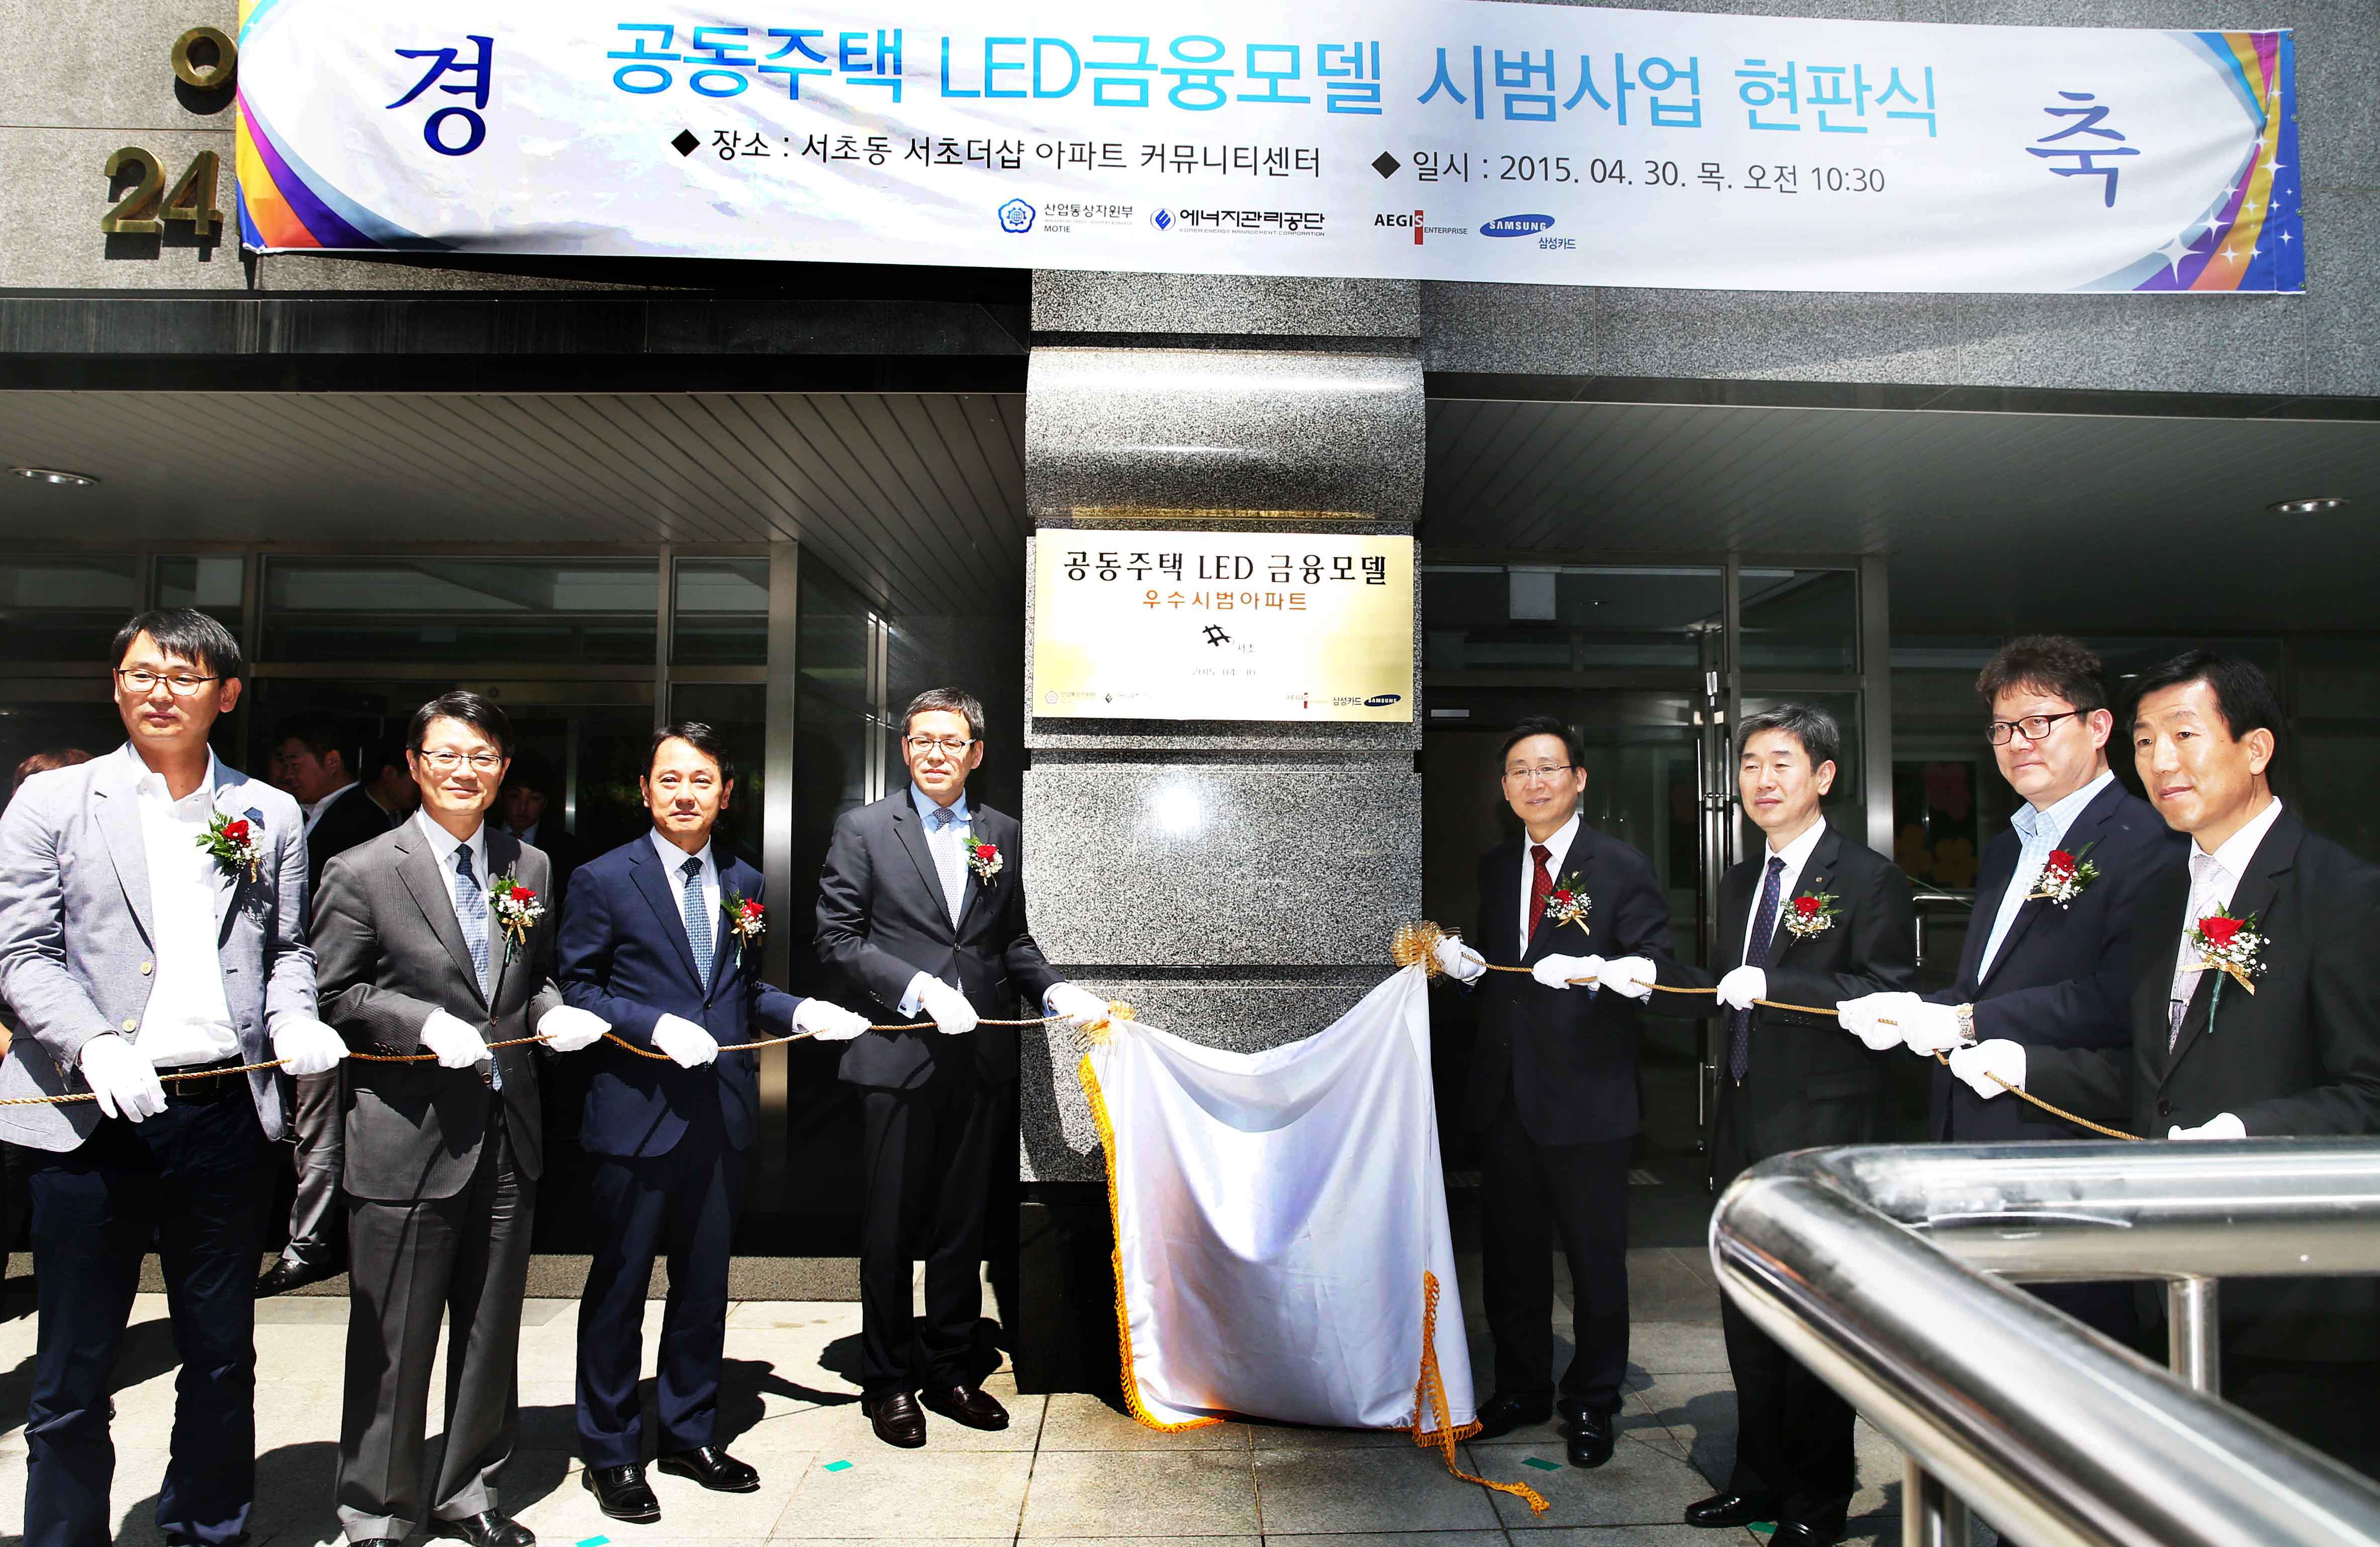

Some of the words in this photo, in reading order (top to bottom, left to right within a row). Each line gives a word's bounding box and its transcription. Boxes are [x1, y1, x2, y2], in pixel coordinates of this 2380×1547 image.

[607, 23, 902, 104] 공동주택
[1417, 44, 1701, 129] 시범사업
[1735, 58, 1938, 138] 현판식
[385, 35, 494, 156] 경
[712, 130, 771, 161] 장소
[801, 133, 892, 165] 서초동
[904, 136, 1024, 170] 서초더샵
[1035, 141, 1127, 171] 아파트
[1140, 144, 1320, 178] 커뮤니티센터
[2025, 90, 2141, 208] 축
[1413, 152, 1468, 183] 일시
[1500, 155, 1578, 184] 2015.
[1590, 158, 1633, 186] 04.
[1645, 160, 1685, 188] 30.
[1697, 162, 1732, 192] 목.
[1744, 164, 1798, 194] 오전
[1812, 167, 1885, 192] 10:30
[1044, 203, 1133, 218] 산업통상자원부
[1180, 209, 1325, 232] 에너지관리공단
[1044, 225, 1070, 233] MOTIE
[1374, 214, 1424, 227] AEGIS
[1424, 227, 1468, 235] ENTERPRISE
[1489, 220, 1547, 231] SAMSUNG
[1539, 237, 1576, 250] 삼성카드
[1063, 551, 1183, 582] 공동주택
[1199, 555, 1254, 580] LED
[1267, 554, 1387, 585] 금융모델
[1332, 696, 1362, 706] 삼성카드
